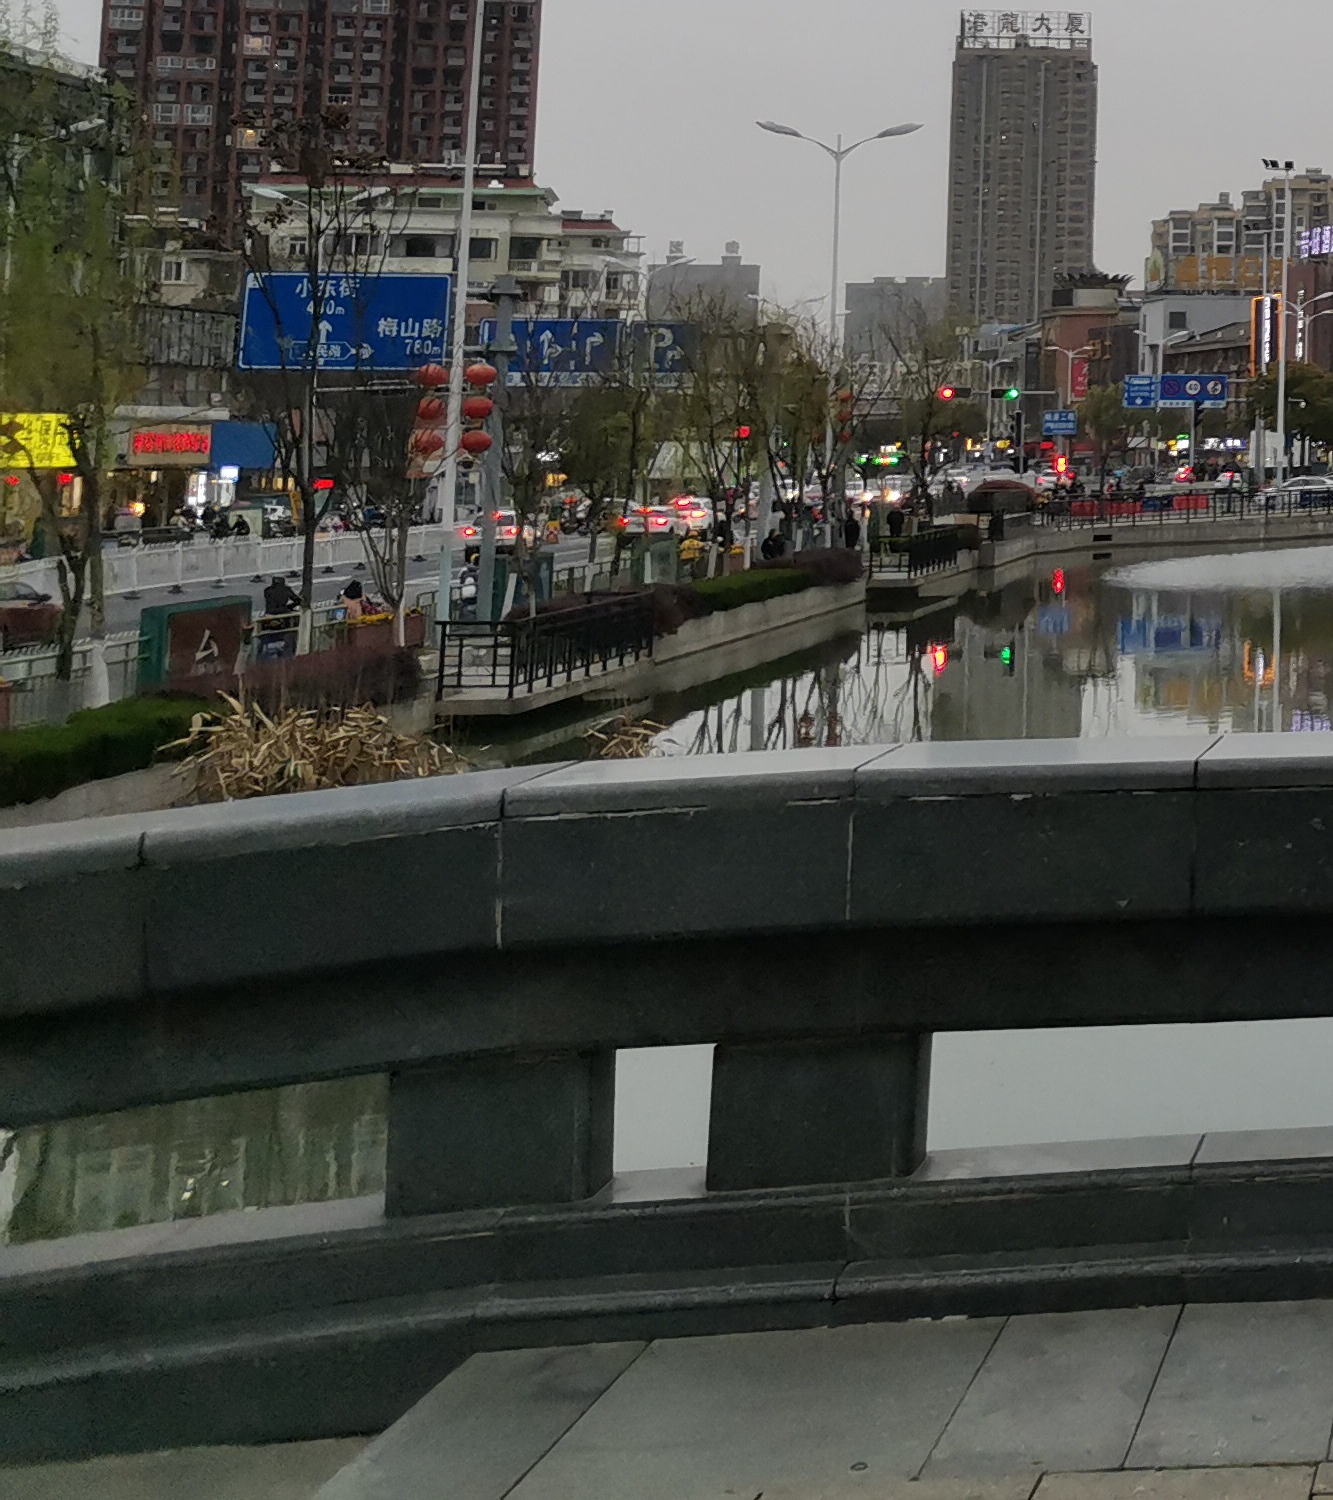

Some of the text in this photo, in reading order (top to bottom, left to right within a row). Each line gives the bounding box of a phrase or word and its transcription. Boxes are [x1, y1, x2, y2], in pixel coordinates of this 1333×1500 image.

[306, 300, 345, 316] 40m
[377, 317, 442, 338] 梅山路
[301, 344, 341, 357] 民路
